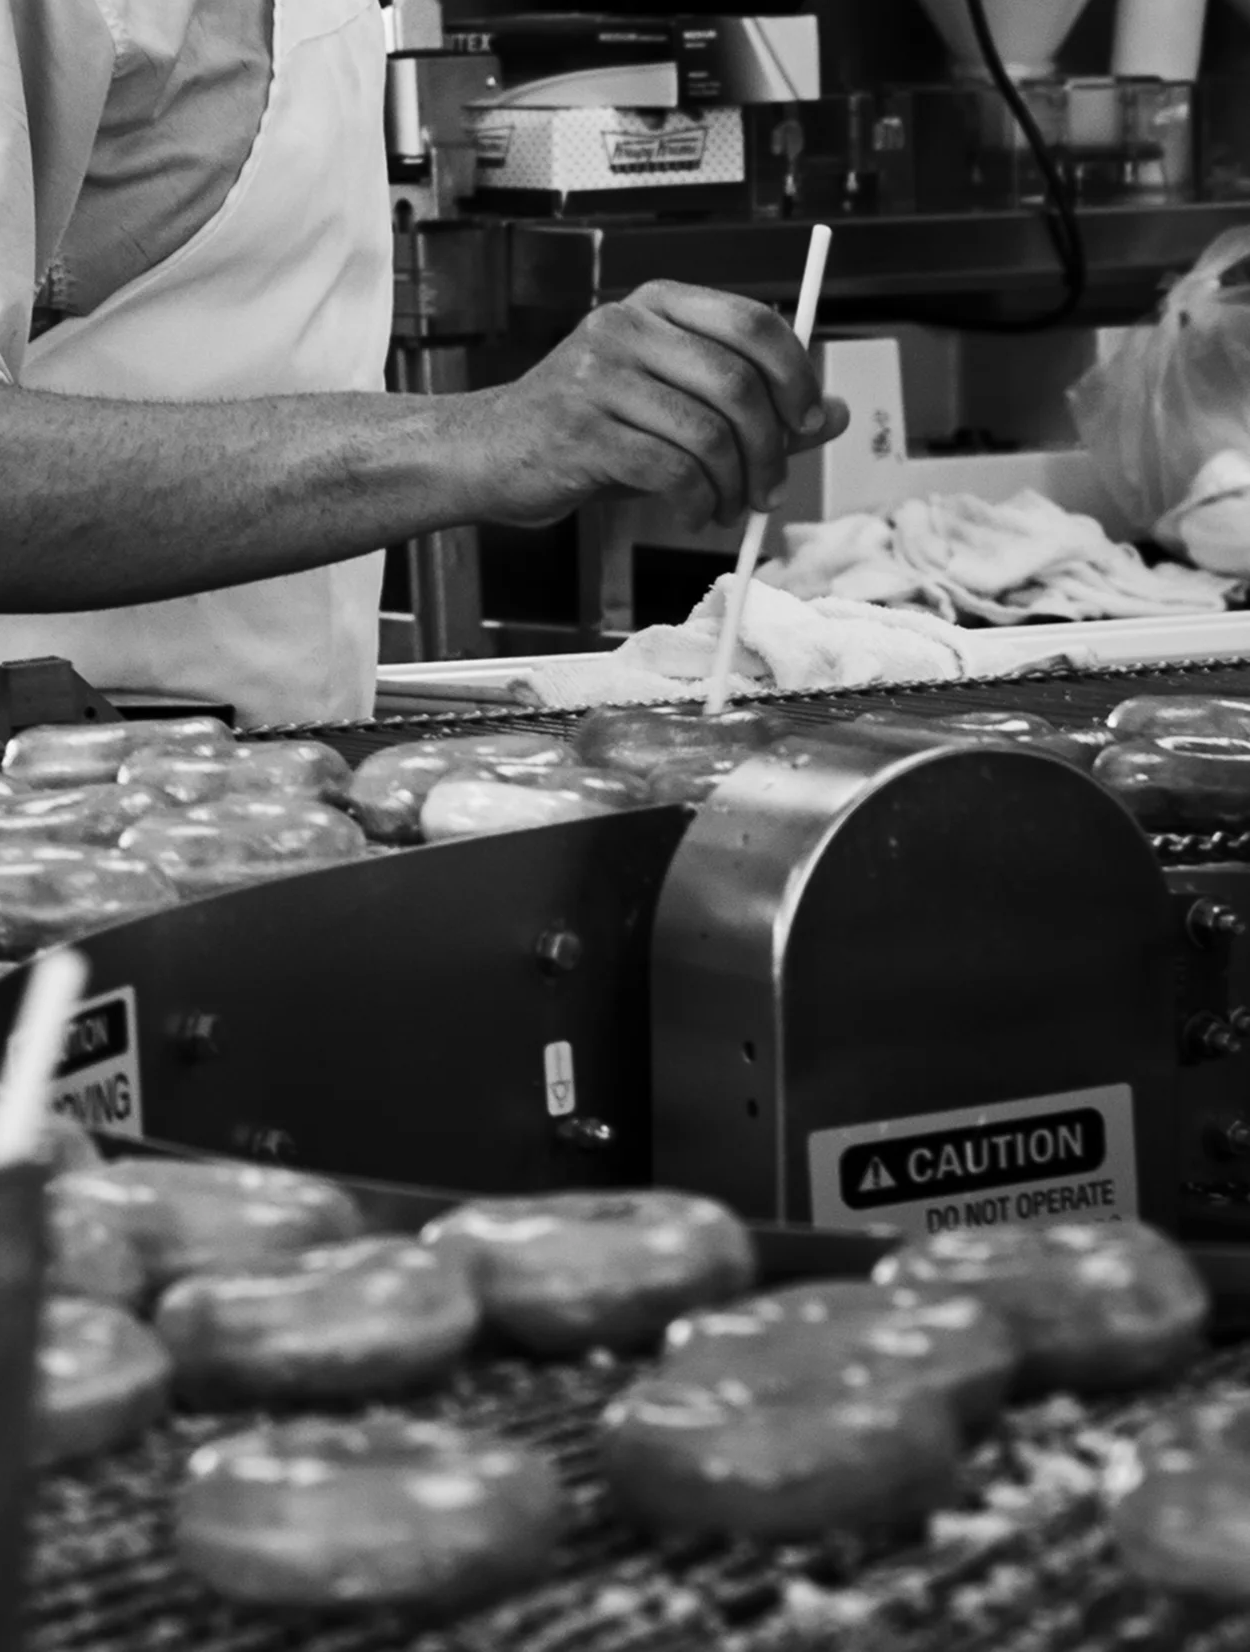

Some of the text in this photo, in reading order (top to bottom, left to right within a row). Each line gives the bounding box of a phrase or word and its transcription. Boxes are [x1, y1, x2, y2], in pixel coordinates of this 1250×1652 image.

[907, 1122, 1084, 1183] CAUTION
[925, 1178, 1116, 1234] DO NOT OPERATE
